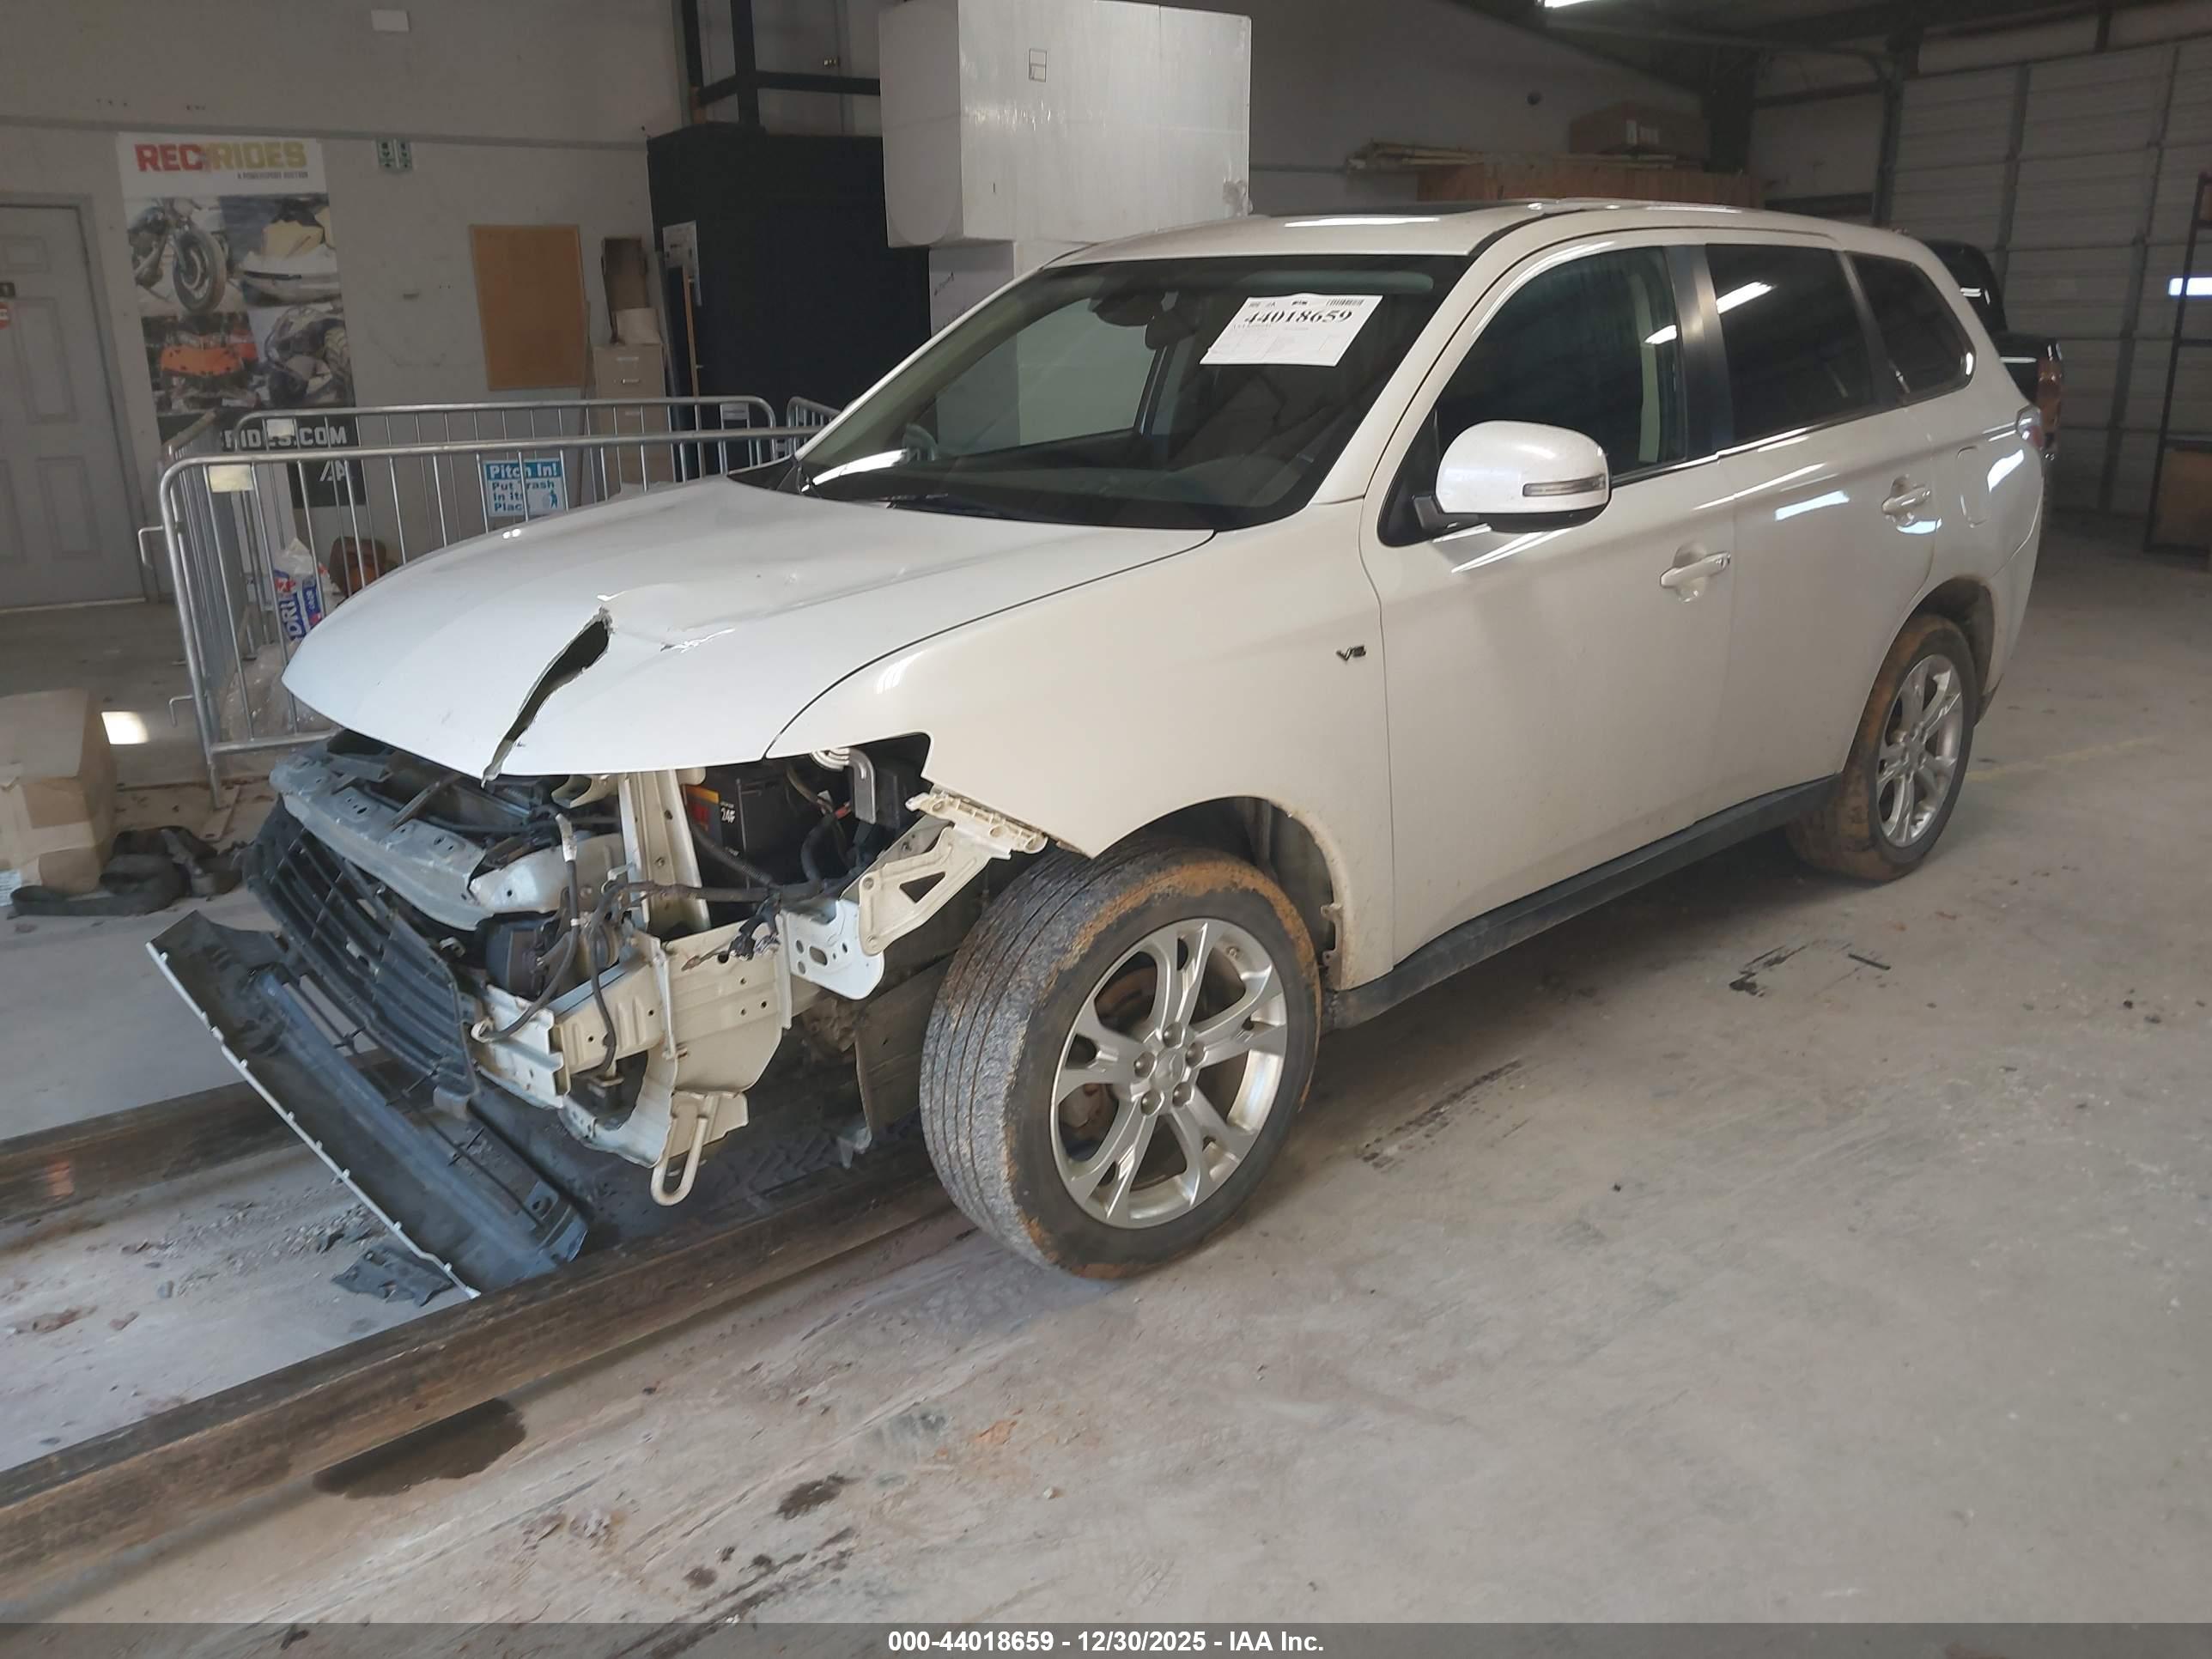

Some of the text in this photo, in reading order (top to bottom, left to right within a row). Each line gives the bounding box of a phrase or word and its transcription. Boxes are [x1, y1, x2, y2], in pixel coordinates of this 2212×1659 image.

[1244, 309, 1353, 324] 44018659
[489, 462, 557, 478] Pitch In!
[492, 482, 514, 491] Put
[494, 491, 525, 501] In it
[495, 502, 530, 512] Plac
